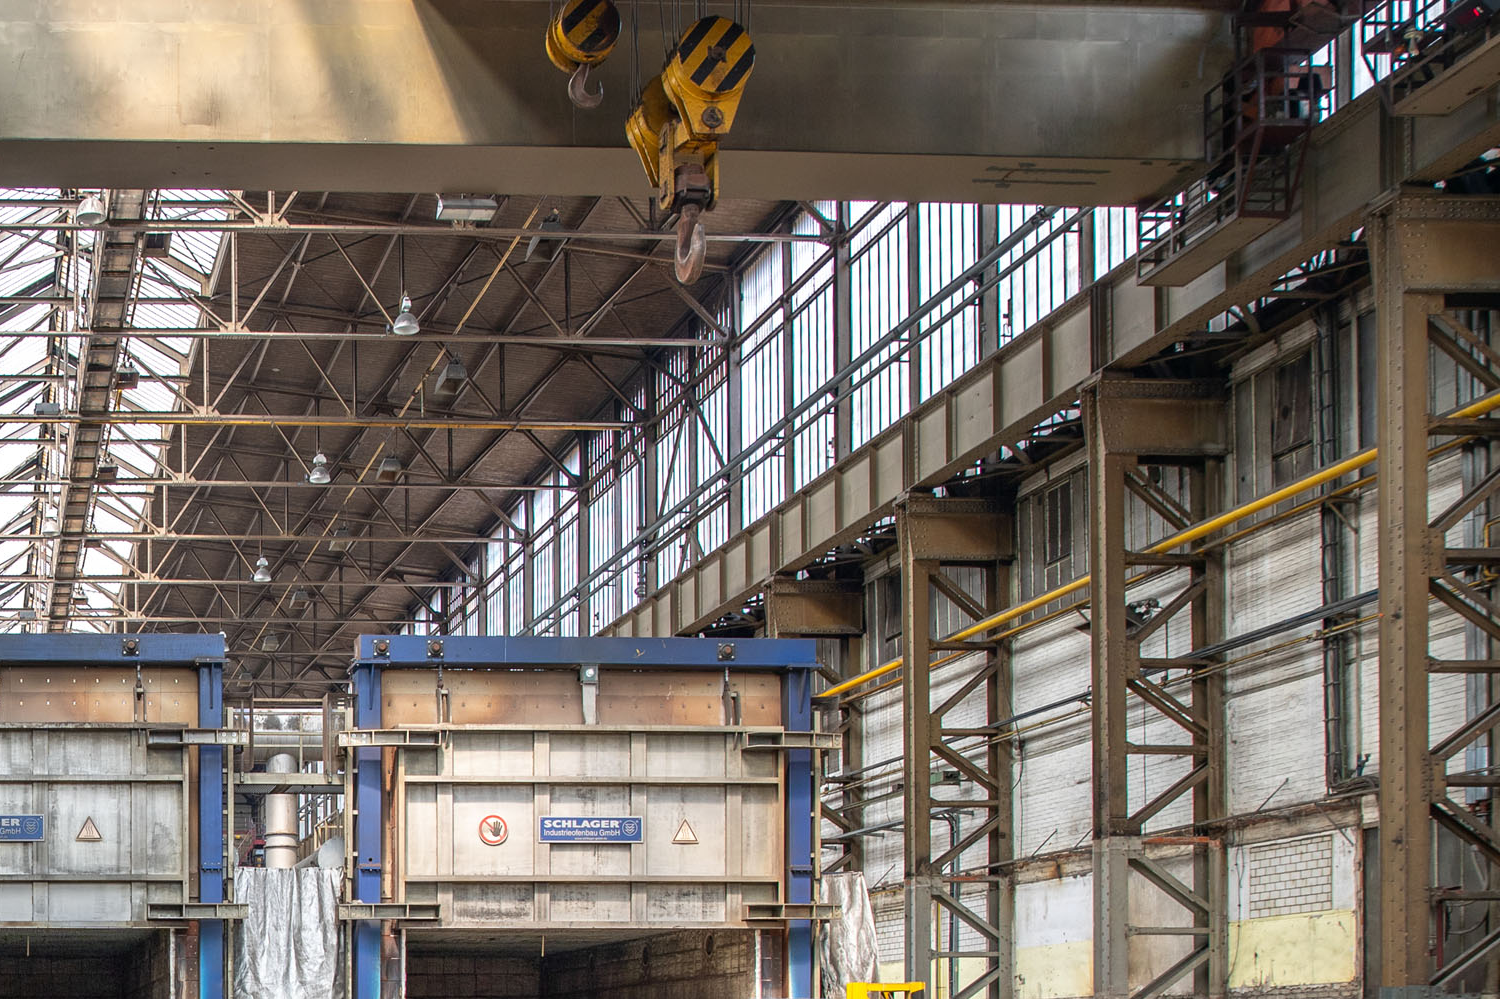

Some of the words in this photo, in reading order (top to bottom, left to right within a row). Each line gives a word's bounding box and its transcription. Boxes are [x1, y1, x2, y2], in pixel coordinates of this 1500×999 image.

[543, 820, 620, 828] SCHLAGER
[0, 827, 21, 835] GmbH
[599, 829, 621, 837] GmbH
